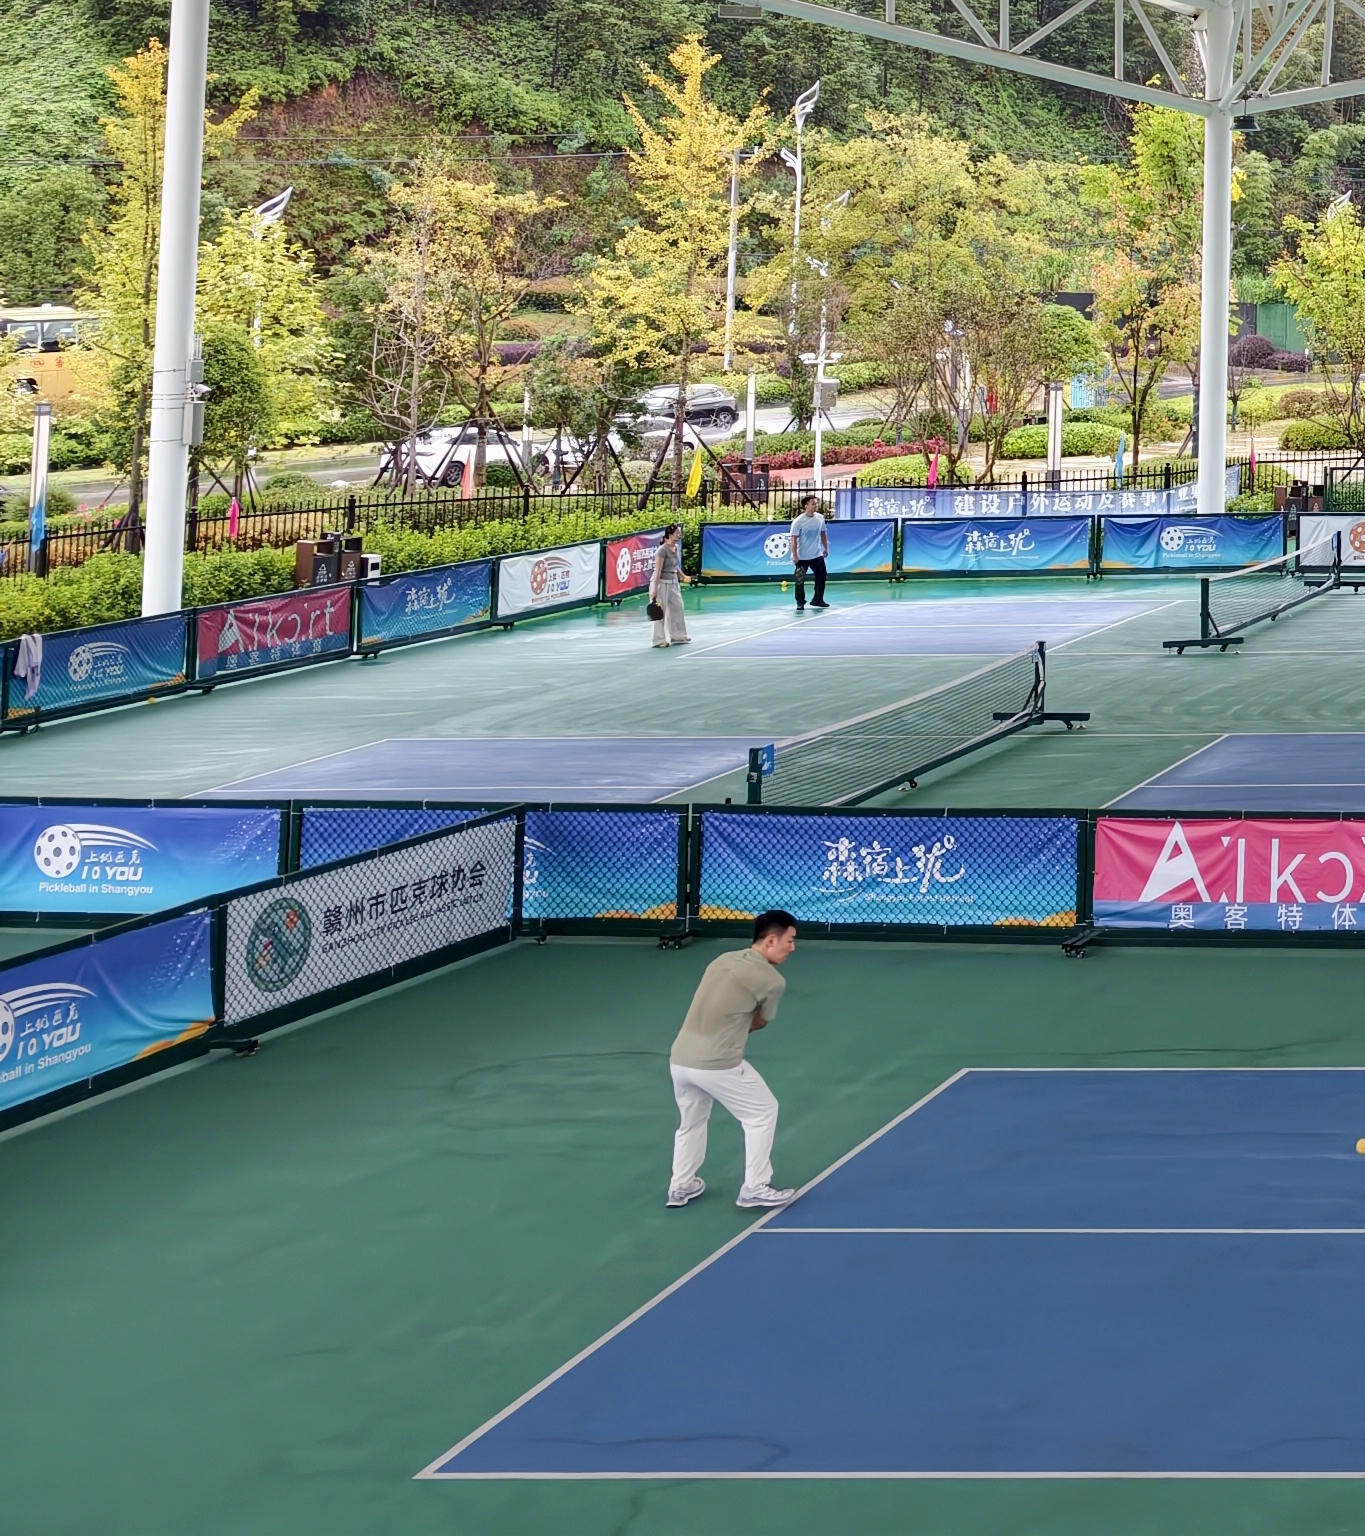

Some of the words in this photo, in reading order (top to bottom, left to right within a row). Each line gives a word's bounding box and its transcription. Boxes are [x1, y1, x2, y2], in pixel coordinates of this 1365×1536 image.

[1196, 544, 1217, 552] YOU
[105, 865, 143, 881] YOU
[38, 882, 86, 894] Pickleball
[89, 883, 98, 894] in
[101, 883, 153, 897] Shangyou
[322, 859, 486, 937] 赣州市匹克球协会
[42, 1022, 82, 1050] YOU
[25, 1062, 34, 1075] in
[37, 1042, 92, 1070] Shangyou
